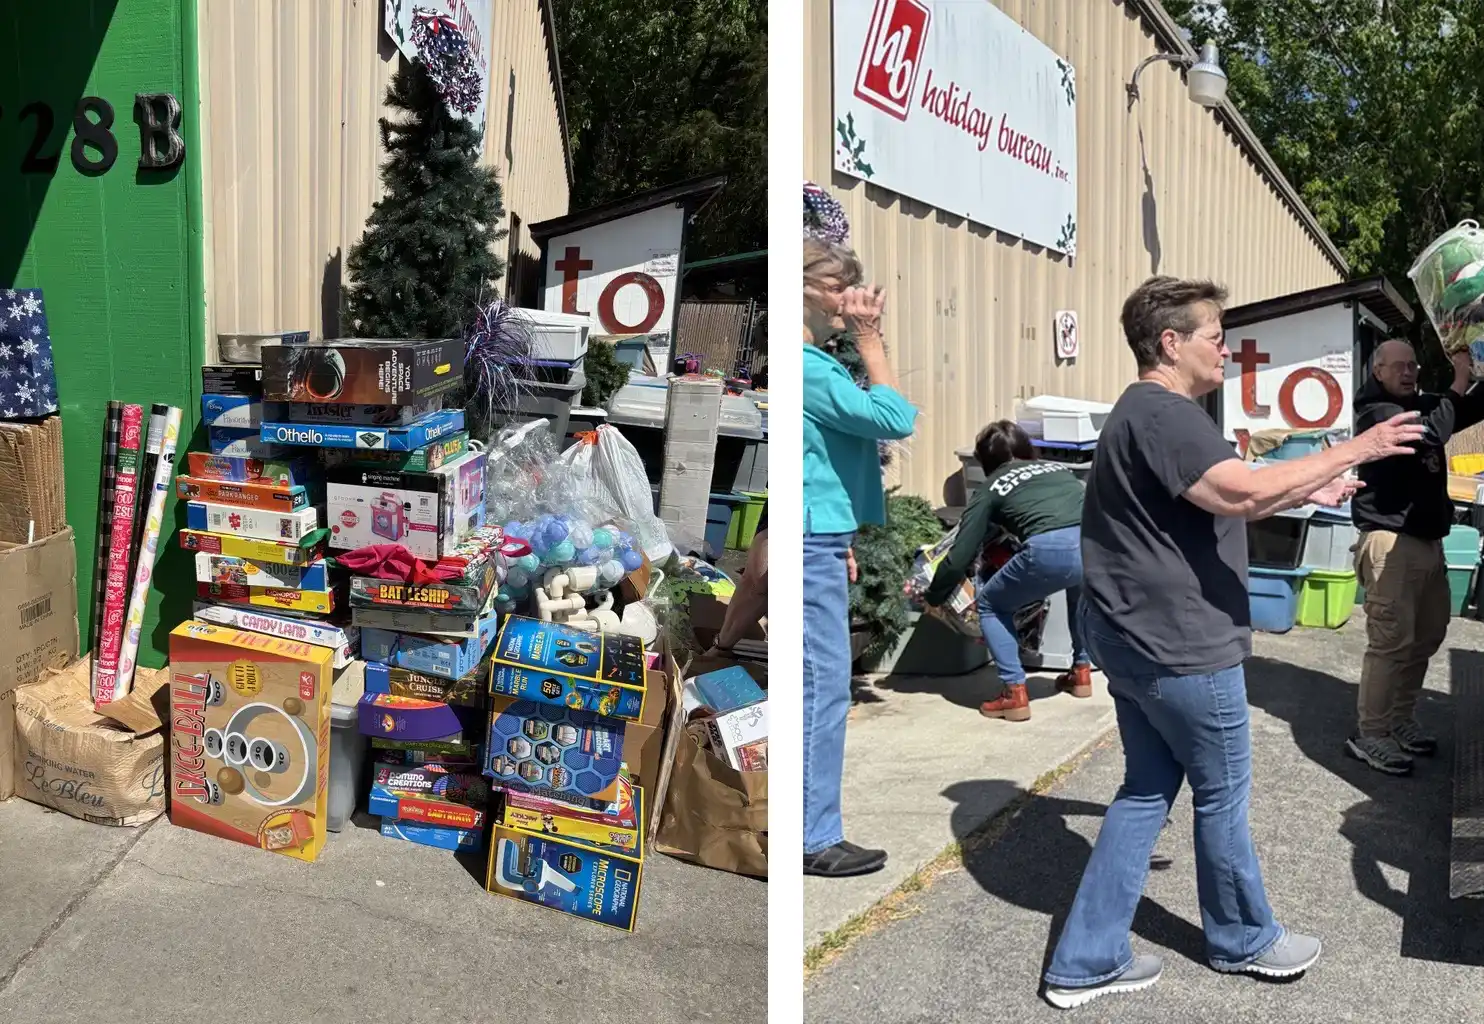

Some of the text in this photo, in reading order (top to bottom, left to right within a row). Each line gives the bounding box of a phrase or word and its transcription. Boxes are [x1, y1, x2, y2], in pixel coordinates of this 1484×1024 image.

[921, 68, 993, 151] holiday
[0, 93, 185, 176] 28 B
[555, 246, 665, 335] to
[1232, 339, 1343, 428] to
[277, 427, 323, 444] Othello
[425, 424, 442, 440] Othello
[368, 473, 400, 482] singing machine
[267, 589, 300, 600] MONOPOLY
[379, 584, 450, 604] BATTLESHIP
[241, 613, 307, 639] CANDY LAND
[407, 673, 446, 686] JUNGLE
[512, 669, 522, 695] MARBLE
[520, 676, 528, 691] RUN
[543, 681, 552, 693] 50
[213, 681, 221, 704] 100
[409, 682, 444, 694] CRUISE
[173, 672, 210, 804] SKEE-BALL
[207, 736, 214, 749] 50
[229, 741, 235, 754] 40
[255, 746, 261, 760] 30
[278, 752, 284, 766] 10
[65, 765, 95, 779] WATER
[389, 772, 424, 781] DOMINO
[388, 780, 432, 788] CREATIONS
[592, 858, 610, 916] MICROSCOPE
[618, 882, 628, 908] NATIONAL
[611, 880, 622, 913] GEOGRAPHIC
